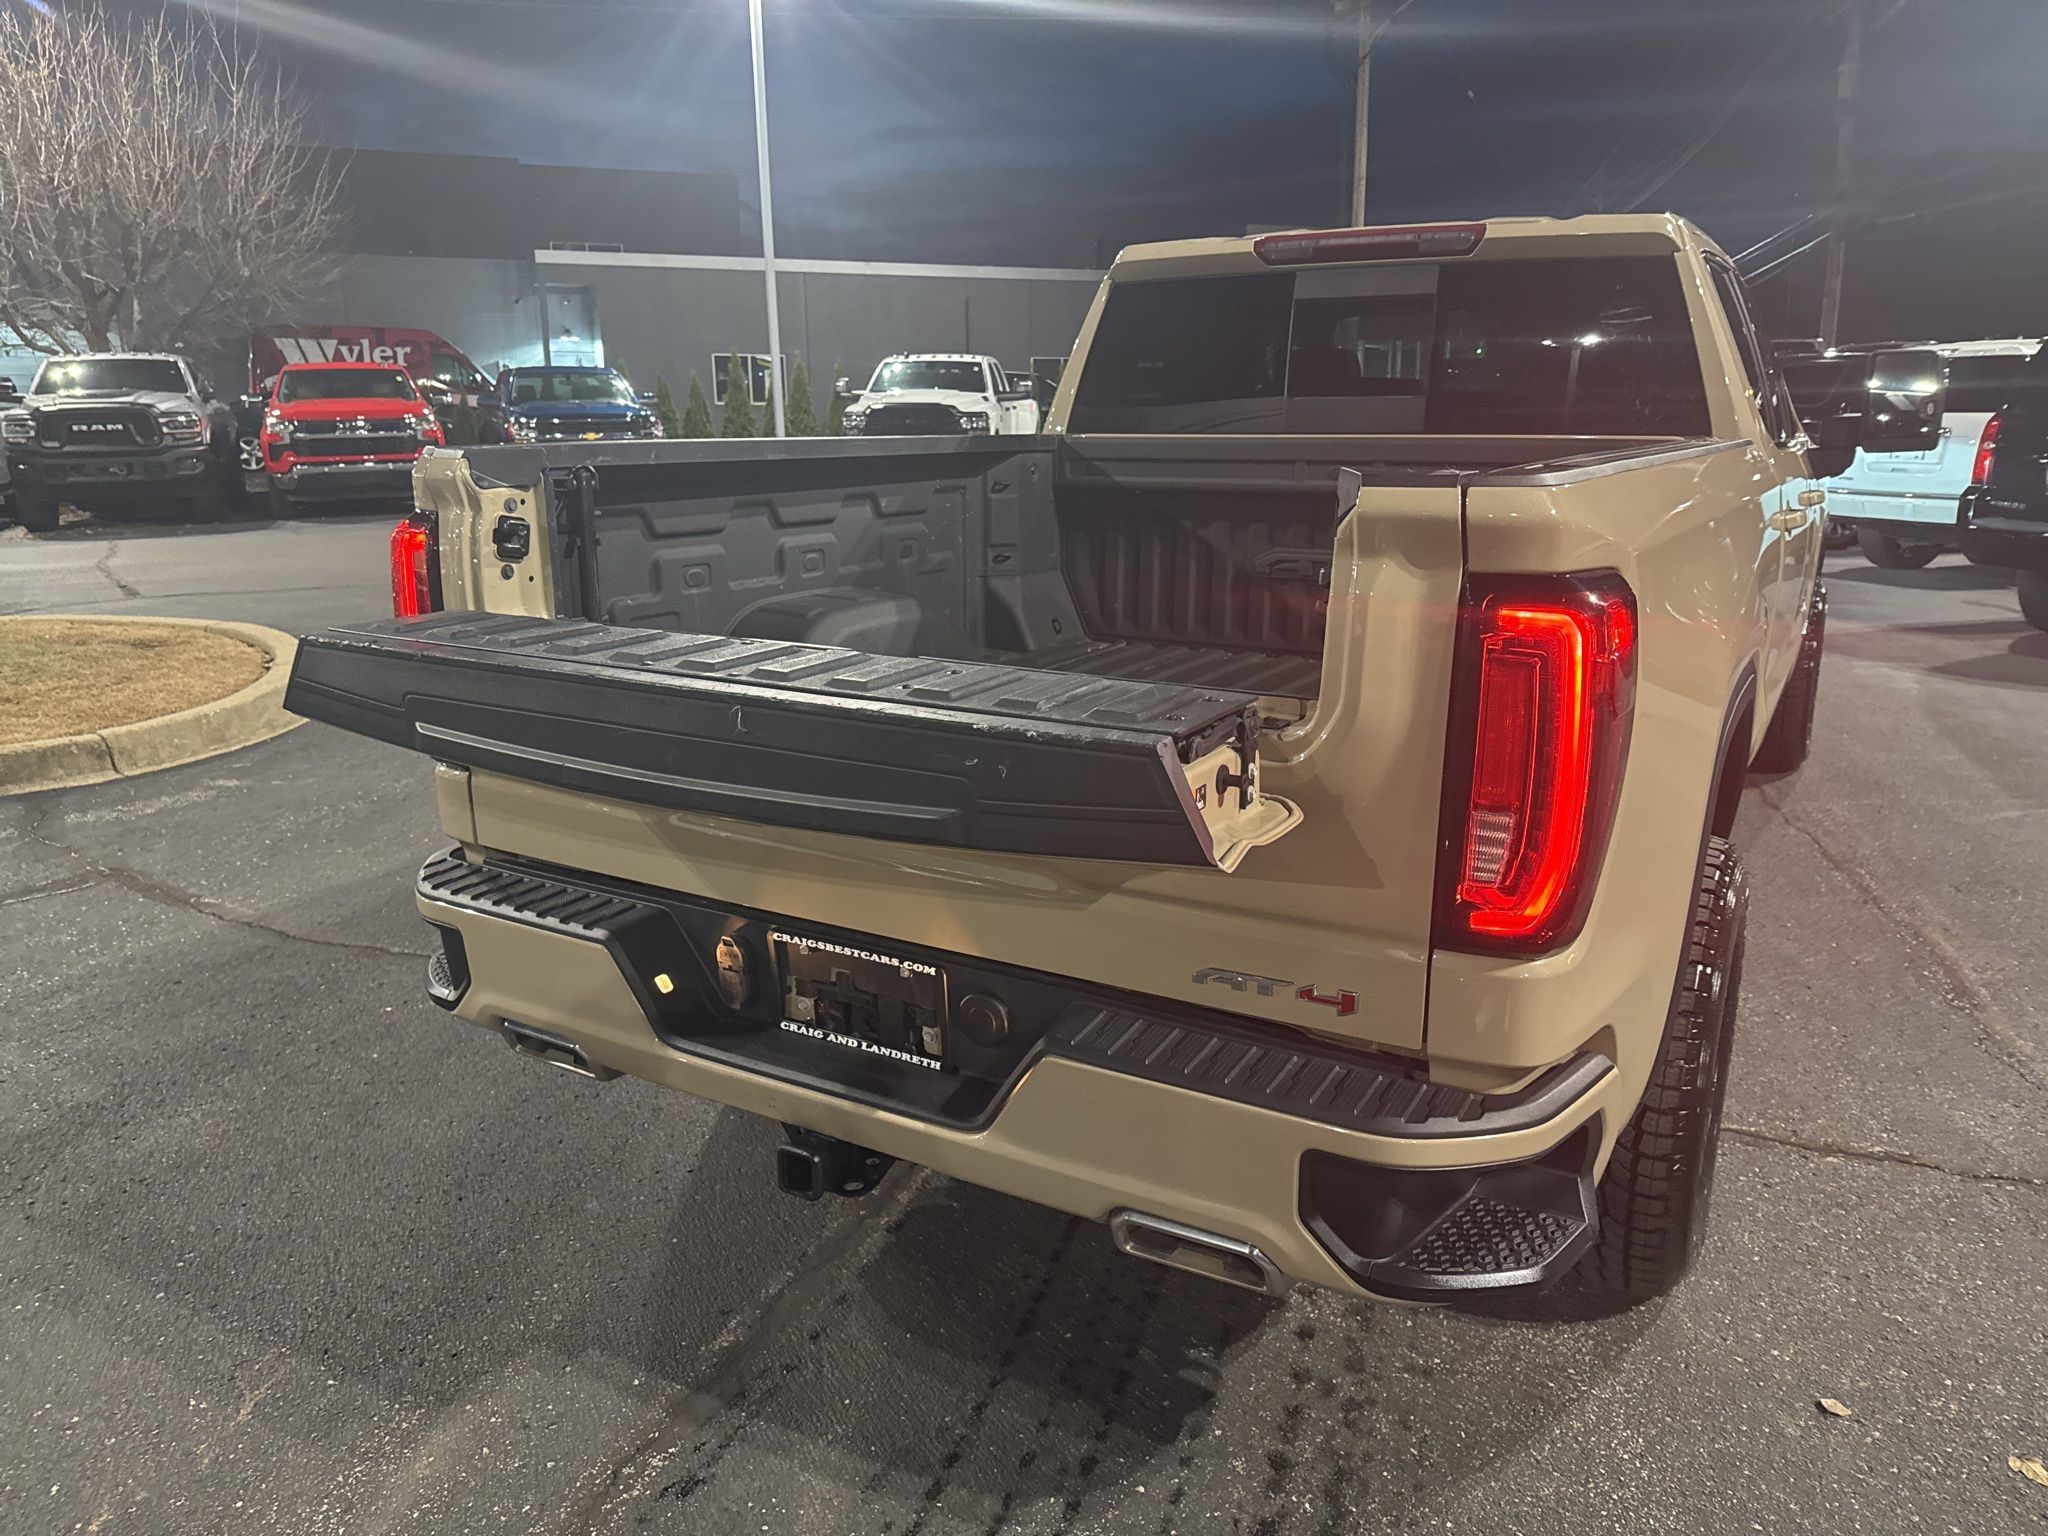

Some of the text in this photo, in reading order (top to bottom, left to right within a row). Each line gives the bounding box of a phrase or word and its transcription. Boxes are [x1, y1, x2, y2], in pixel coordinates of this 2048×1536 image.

[71, 424, 124, 432] RAM
[772, 932, 937, 976] CRAIGSBESTCARS.COM
[1191, 967, 1360, 1017] AT4
[780, 1021, 942, 1071] CRAIG AND LANDRETH
